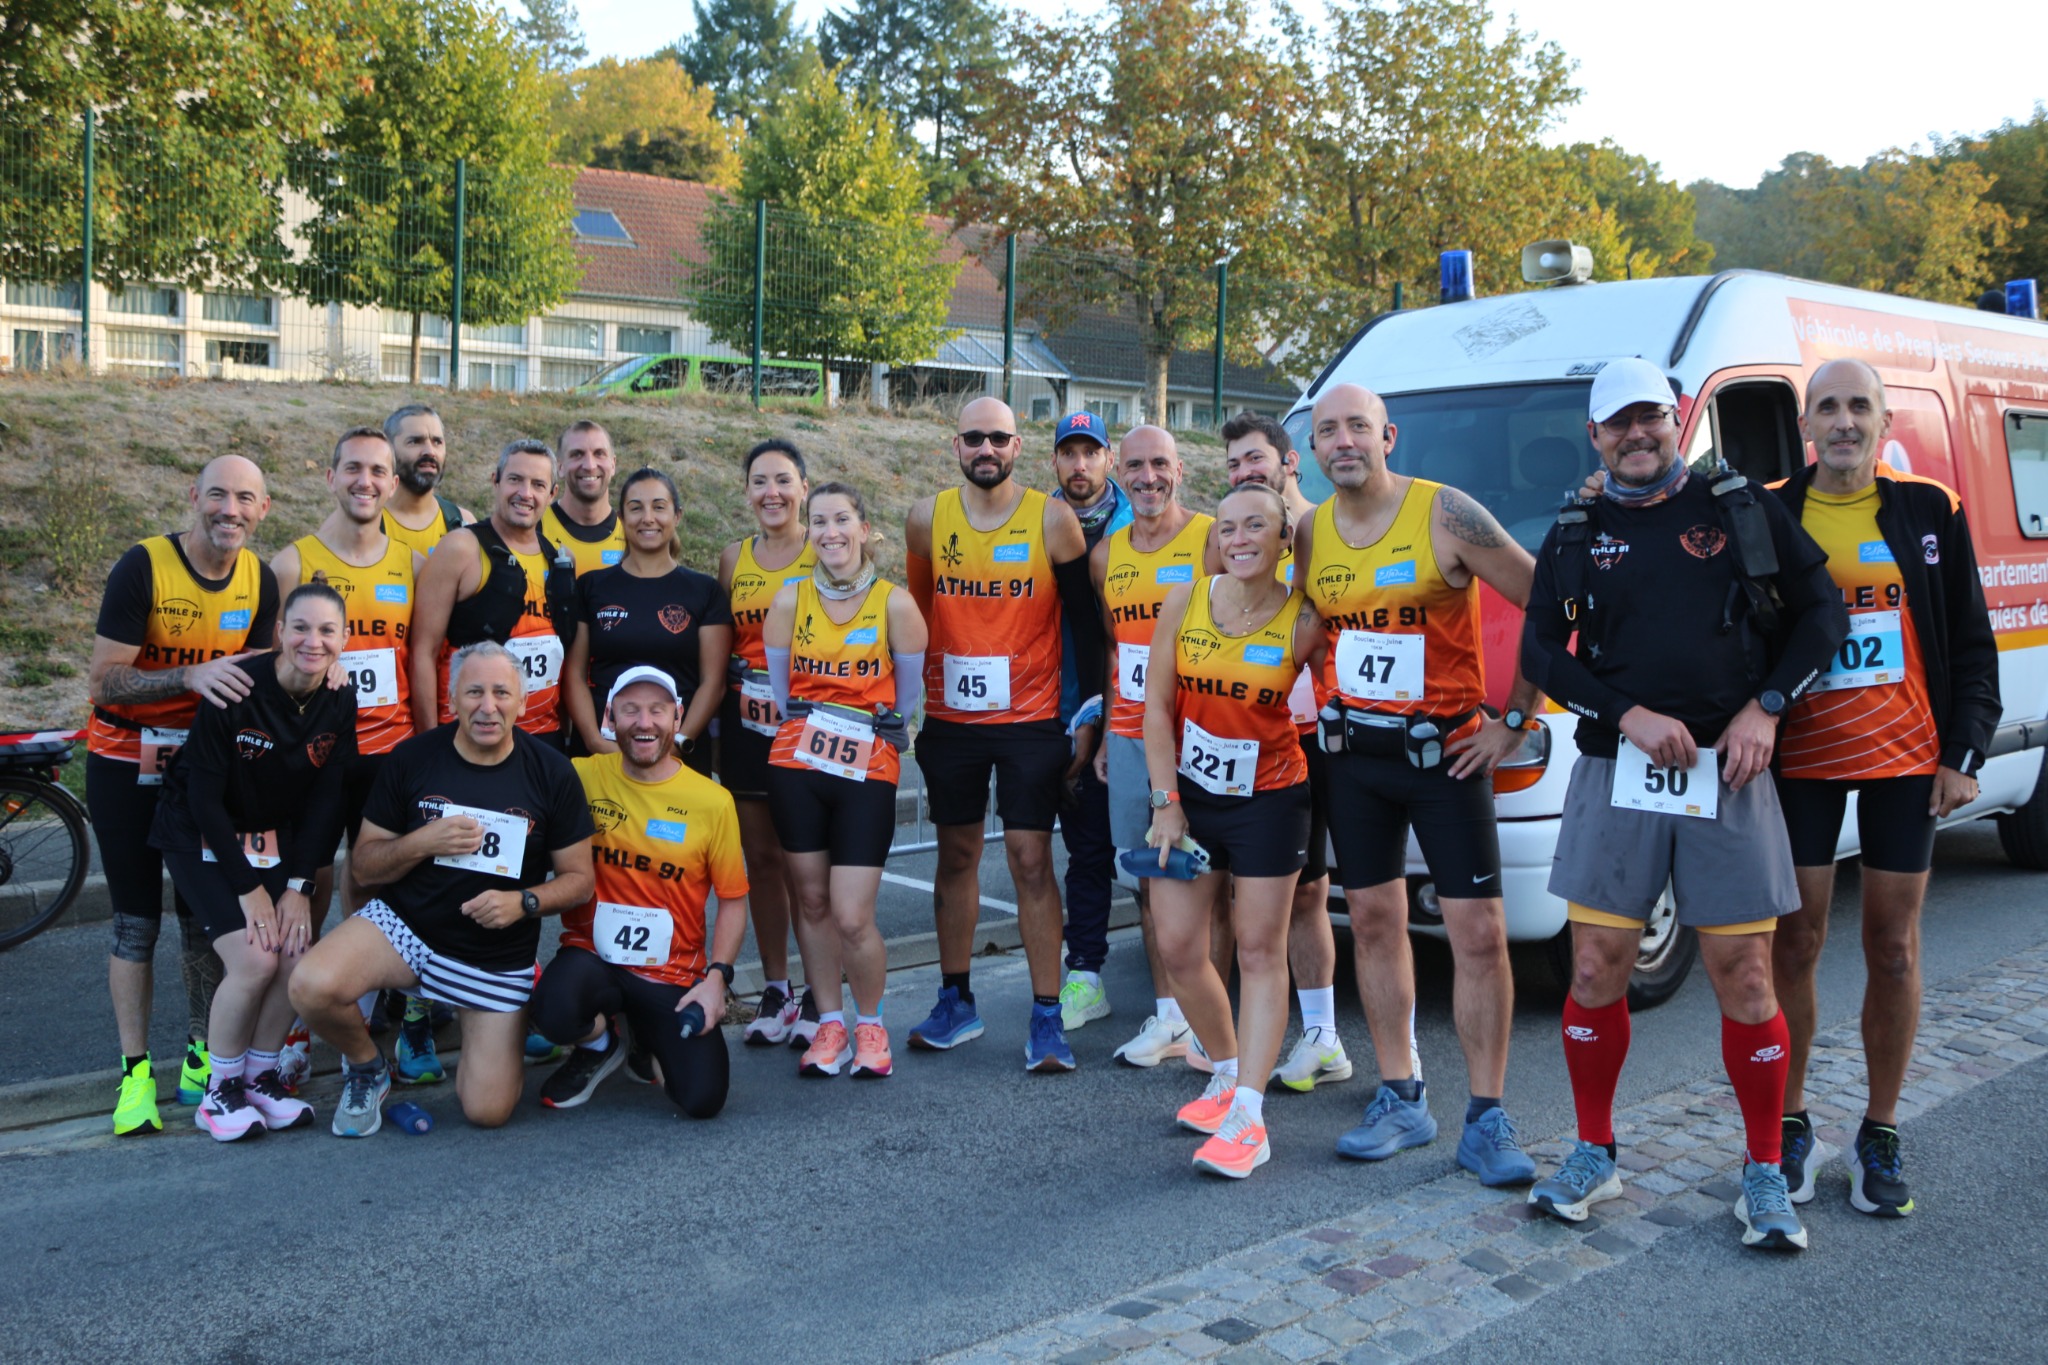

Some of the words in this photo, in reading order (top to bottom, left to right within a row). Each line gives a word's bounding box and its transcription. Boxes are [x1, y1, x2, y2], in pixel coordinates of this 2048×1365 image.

[1792, 315, 1868, 350] Véhicule
[1873, 328, 1893, 353] de
[1895, 331, 1963, 361] Premiers
[1964, 341, 2018, 367] Secours
[757, 579, 766, 588] 91
[936, 574, 1003, 598] ATHLE
[1009, 577, 1035, 599] 91
[1108, 573, 1129, 583] ATHLE
[1130, 570, 1140, 579] 91
[1317, 574, 1343, 587] ATHLE
[1345, 573, 1356, 582] 91
[1885, 583, 1908, 606] 9
[156, 606, 189, 617] ATHLE
[191, 611, 203, 620] 91
[1325, 607, 1390, 634] ATHLE
[1399, 605, 1428, 627] 91
[2030, 598, 2048, 626] de
[395, 621, 408, 640] 9
[1181, 635, 1207, 647] ATHLE
[1210, 641, 1221, 650] 91
[1265, 630, 1285, 640] POLI
[1826, 635, 1884, 672] 02
[523, 654, 548, 678] 43
[793, 656, 850, 678] ATHLE
[856, 657, 880, 678] 91
[1132, 663, 1145, 688] 4
[1358, 654, 1396, 684] 47
[348, 668, 377, 694] 49
[958, 675, 987, 699] 45
[1178, 673, 1249, 701] ATHLE
[1256, 687, 1285, 708] 91
[1791, 668, 1819, 700] KIPRUN
[1567, 700, 1599, 720] KIPRUN
[263, 741, 274, 750] 91
[810, 729, 860, 765] 615
[1191, 744, 1237, 783] 221
[1644, 762, 1689, 797] 50
[617, 812, 628, 823] 91
[666, 806, 688, 816] POLI
[471, 831, 501, 859] 8
[592, 845, 651, 872] THLE
[658, 861, 685, 883] 91
[614, 925, 651, 952] 42
[1571, 1034, 1599, 1042] SPORT
[1762, 1051, 1785, 1063] SPORT
